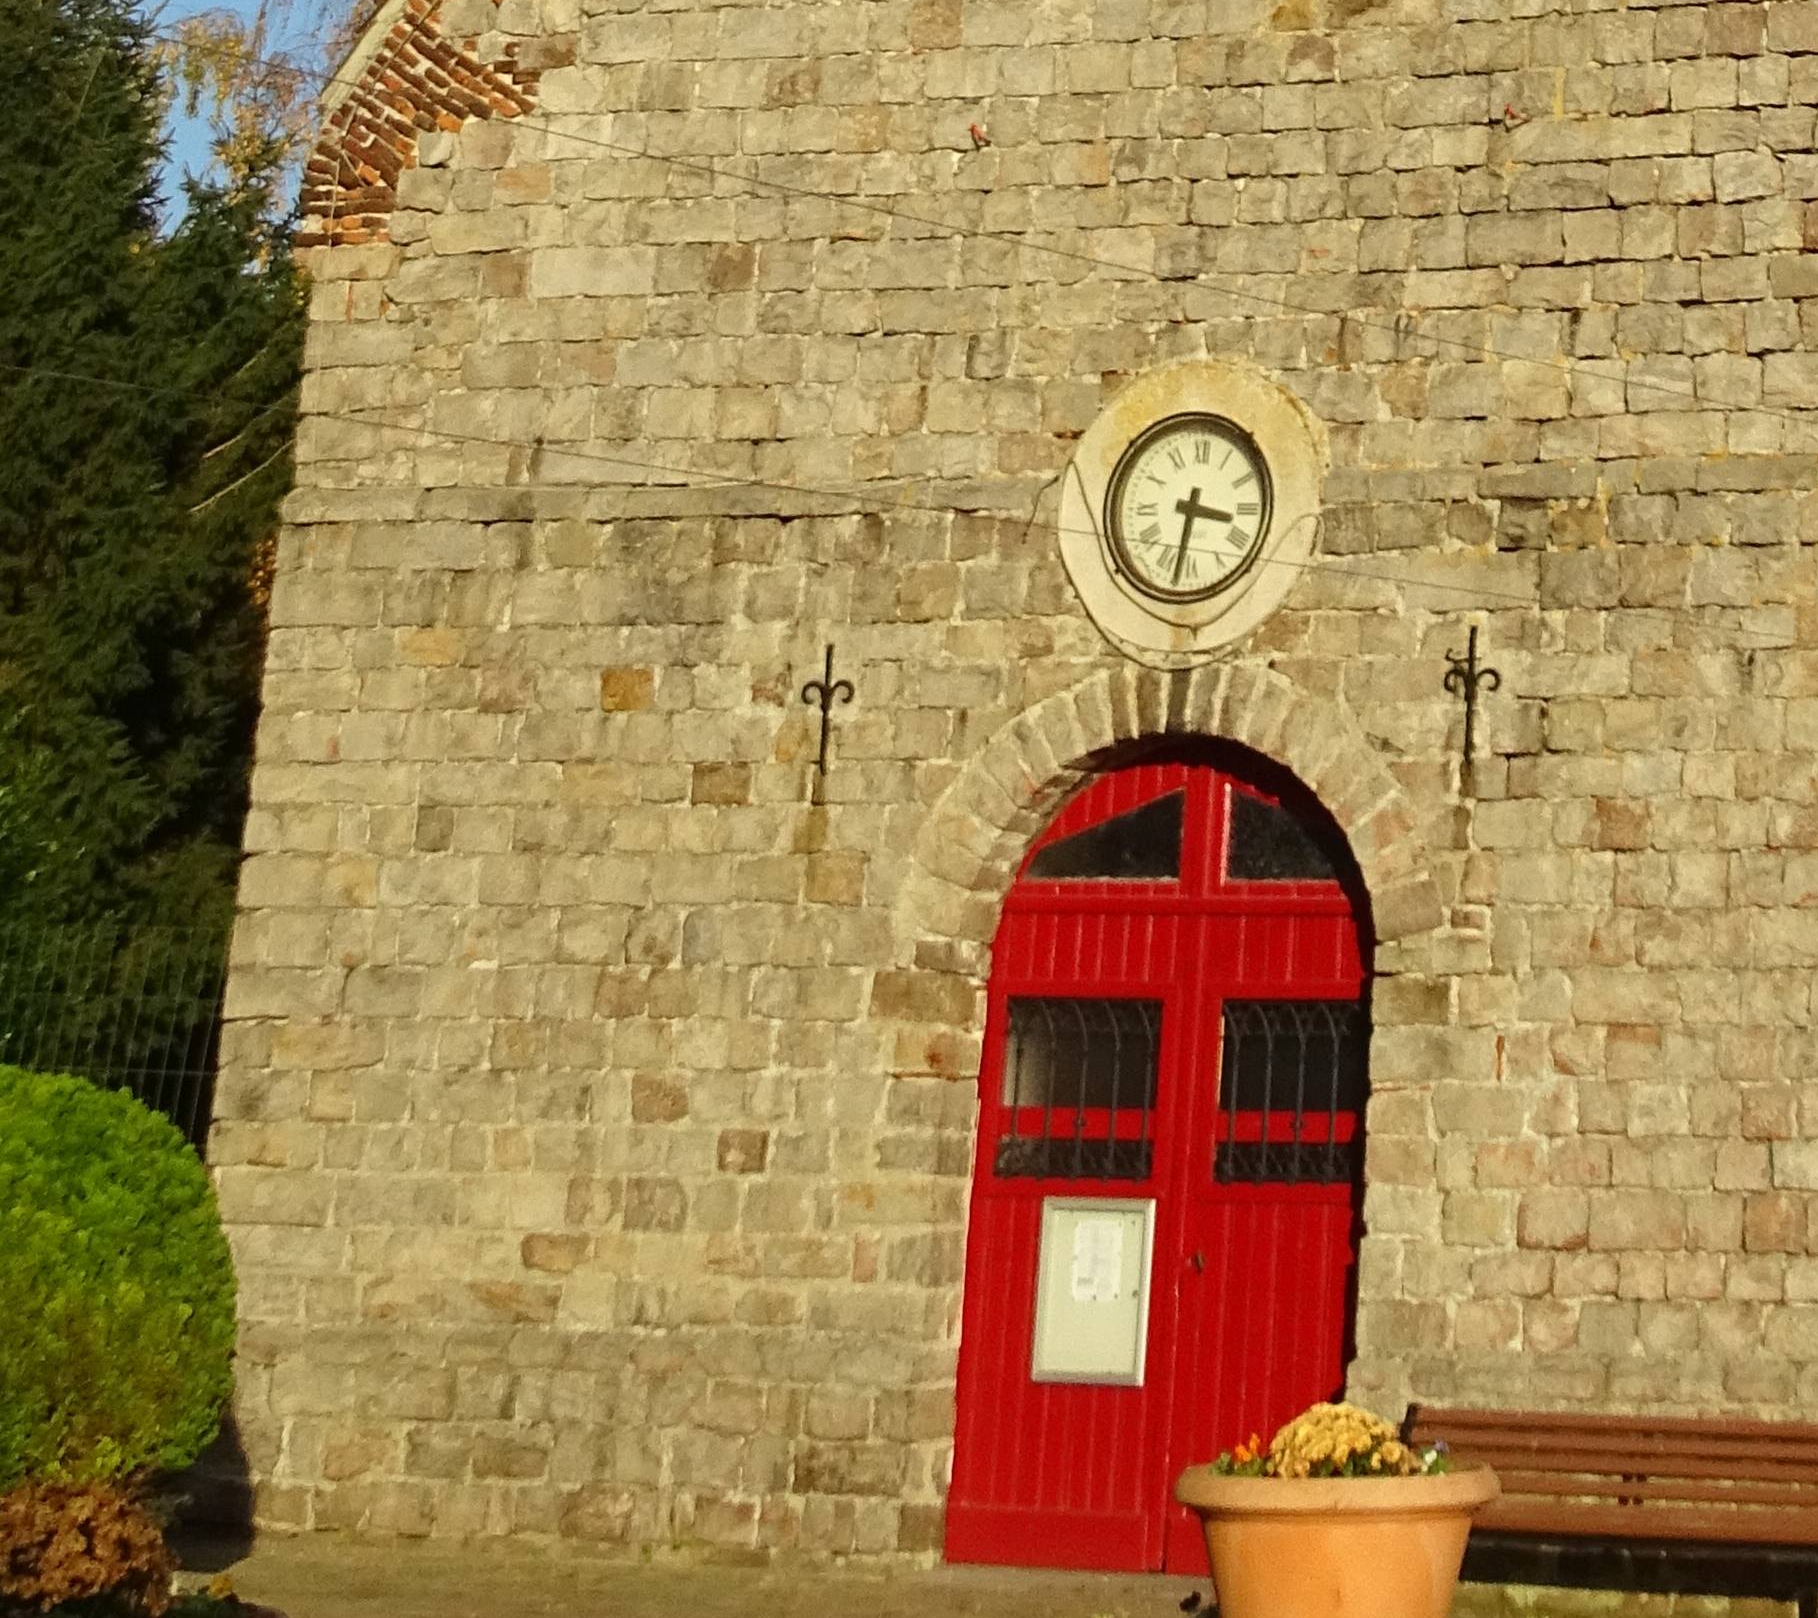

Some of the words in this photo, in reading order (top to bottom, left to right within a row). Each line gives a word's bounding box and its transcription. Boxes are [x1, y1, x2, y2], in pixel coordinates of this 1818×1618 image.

[1167, 446, 1186, 473] XI
[1194, 439, 1212, 464] XII
[1231, 471, 1255, 490] II
[1136, 501, 1159, 516] IX
[1236, 502, 1259, 516] III
